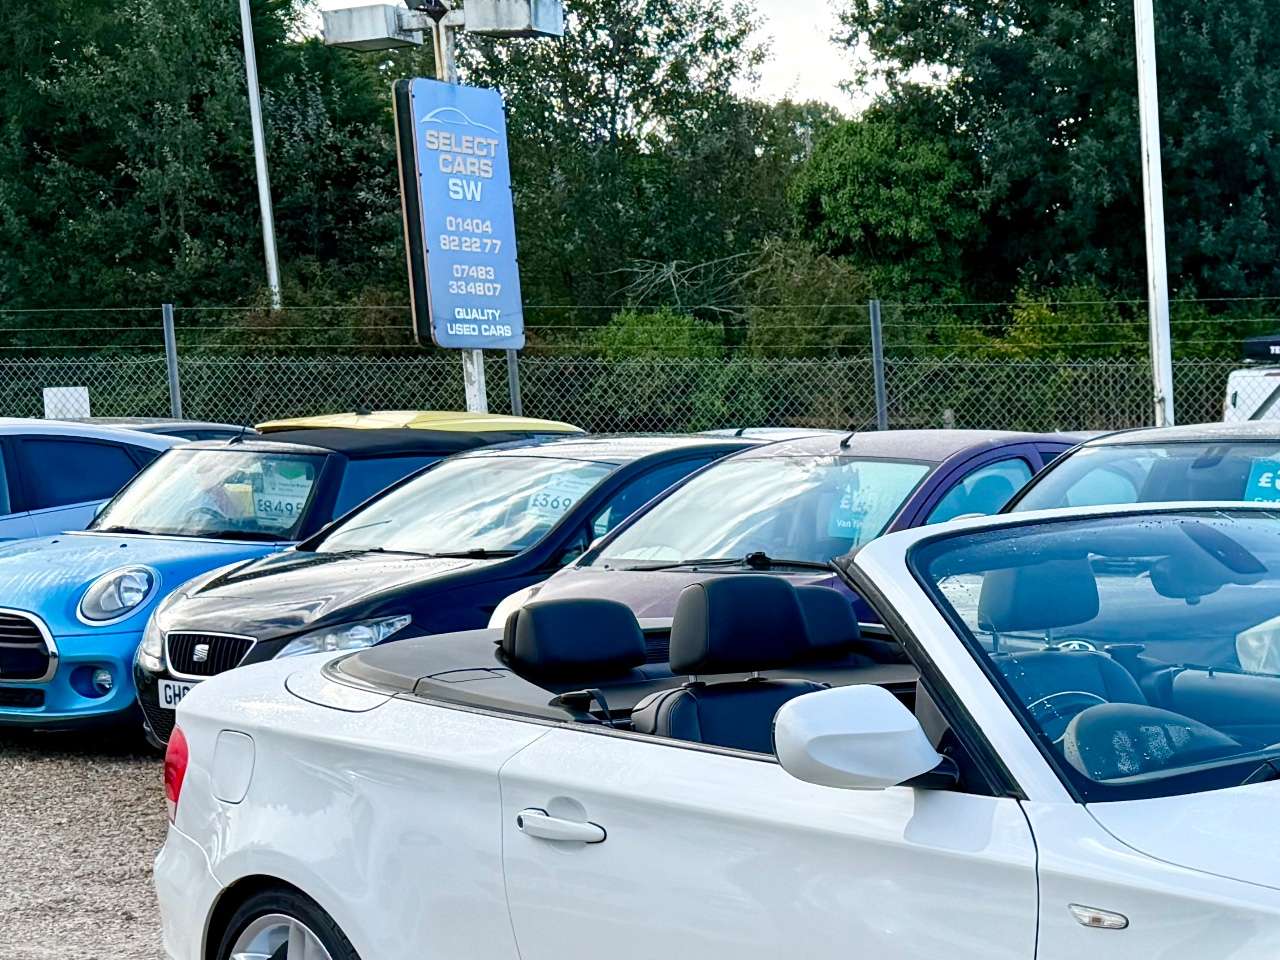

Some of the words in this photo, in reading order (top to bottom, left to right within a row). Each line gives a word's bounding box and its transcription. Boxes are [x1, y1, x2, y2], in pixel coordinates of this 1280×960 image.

[425, 129, 499, 157] SELECT
[438, 155, 494, 179] CARS
[448, 178, 482, 202] SW
[446, 215, 493, 234] 01404
[452, 264, 495, 280] 07483
[448, 280, 502, 297] 334807
[454, 307, 501, 321] QUALITY
[447, 323, 479, 336] USED
[481, 324, 512, 337] CARS
